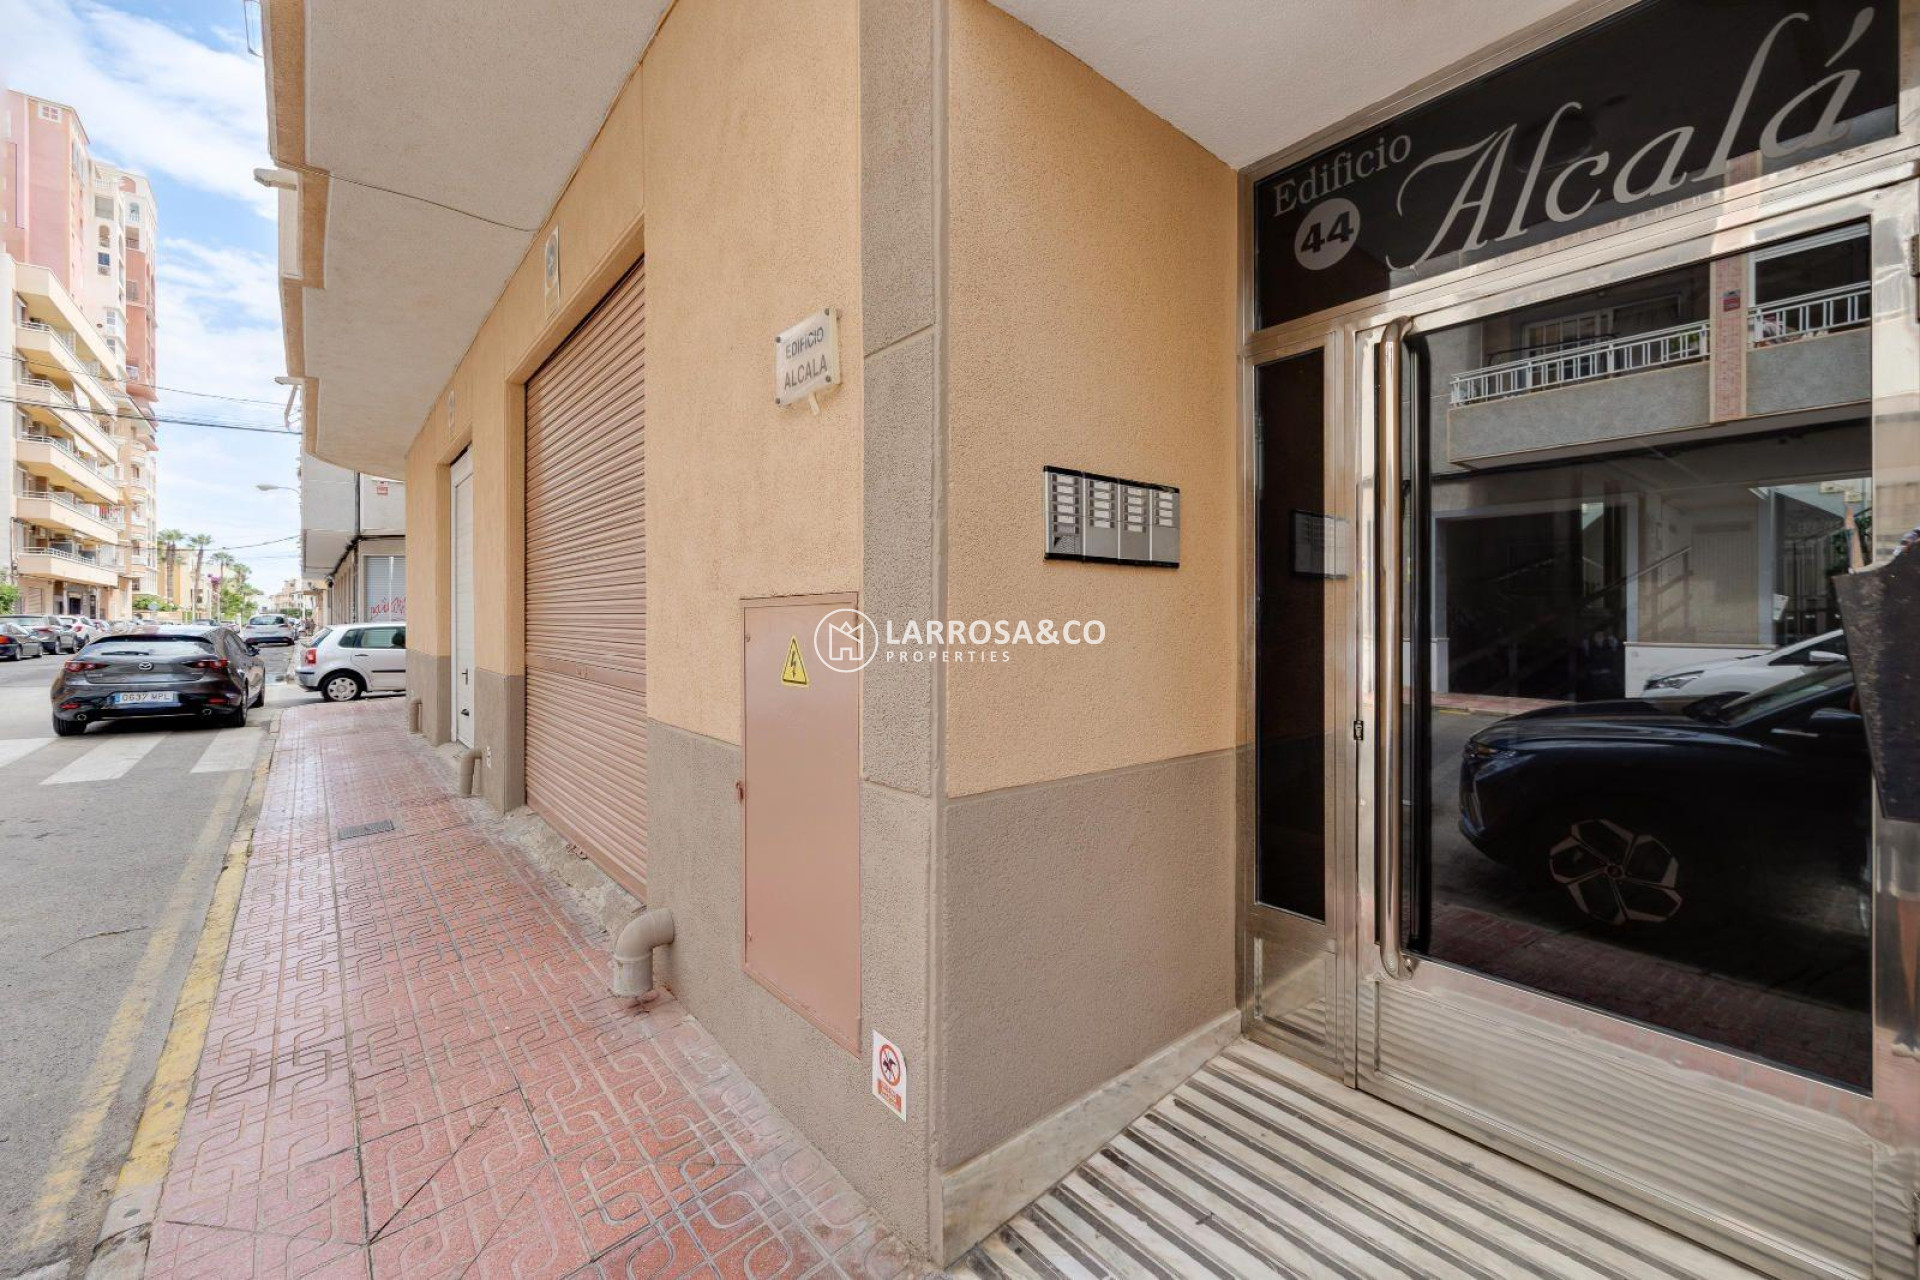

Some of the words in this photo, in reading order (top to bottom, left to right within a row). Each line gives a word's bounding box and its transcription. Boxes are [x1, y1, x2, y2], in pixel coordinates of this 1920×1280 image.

[1385, 6, 1875, 276] Alcalá
[1273, 134, 1412, 217] Edificio
[1301, 211, 1355, 253] 44
[785, 326, 824, 359] EDIFICIO
[784, 354, 828, 390] ALCALA
